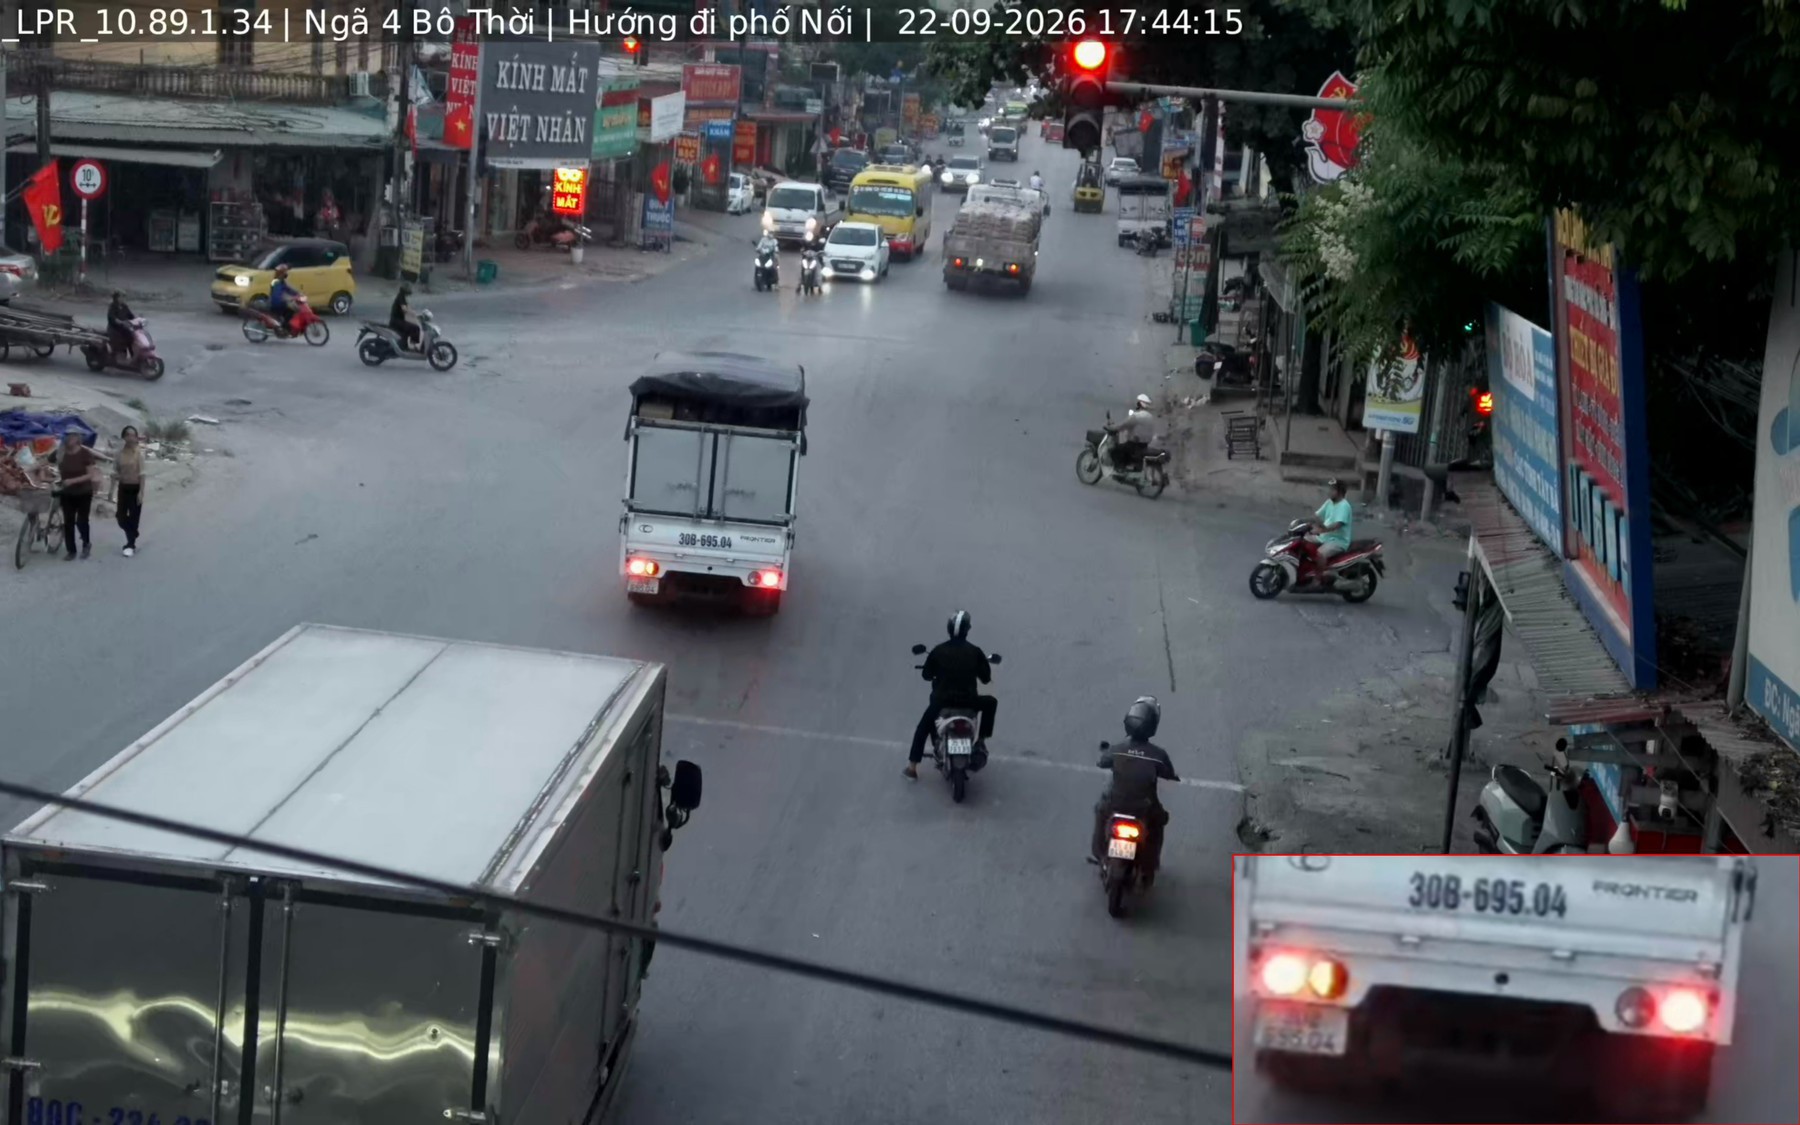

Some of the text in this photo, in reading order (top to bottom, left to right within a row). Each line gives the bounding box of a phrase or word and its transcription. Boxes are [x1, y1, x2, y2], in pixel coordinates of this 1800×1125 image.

[496, 51, 588, 94] KÍNH MẮT
[485, 104, 531, 148] VIỆT
[555, 180, 582, 194] KÍNH
[679, 532, 776, 549] 30B-695.04 FRONTIER
